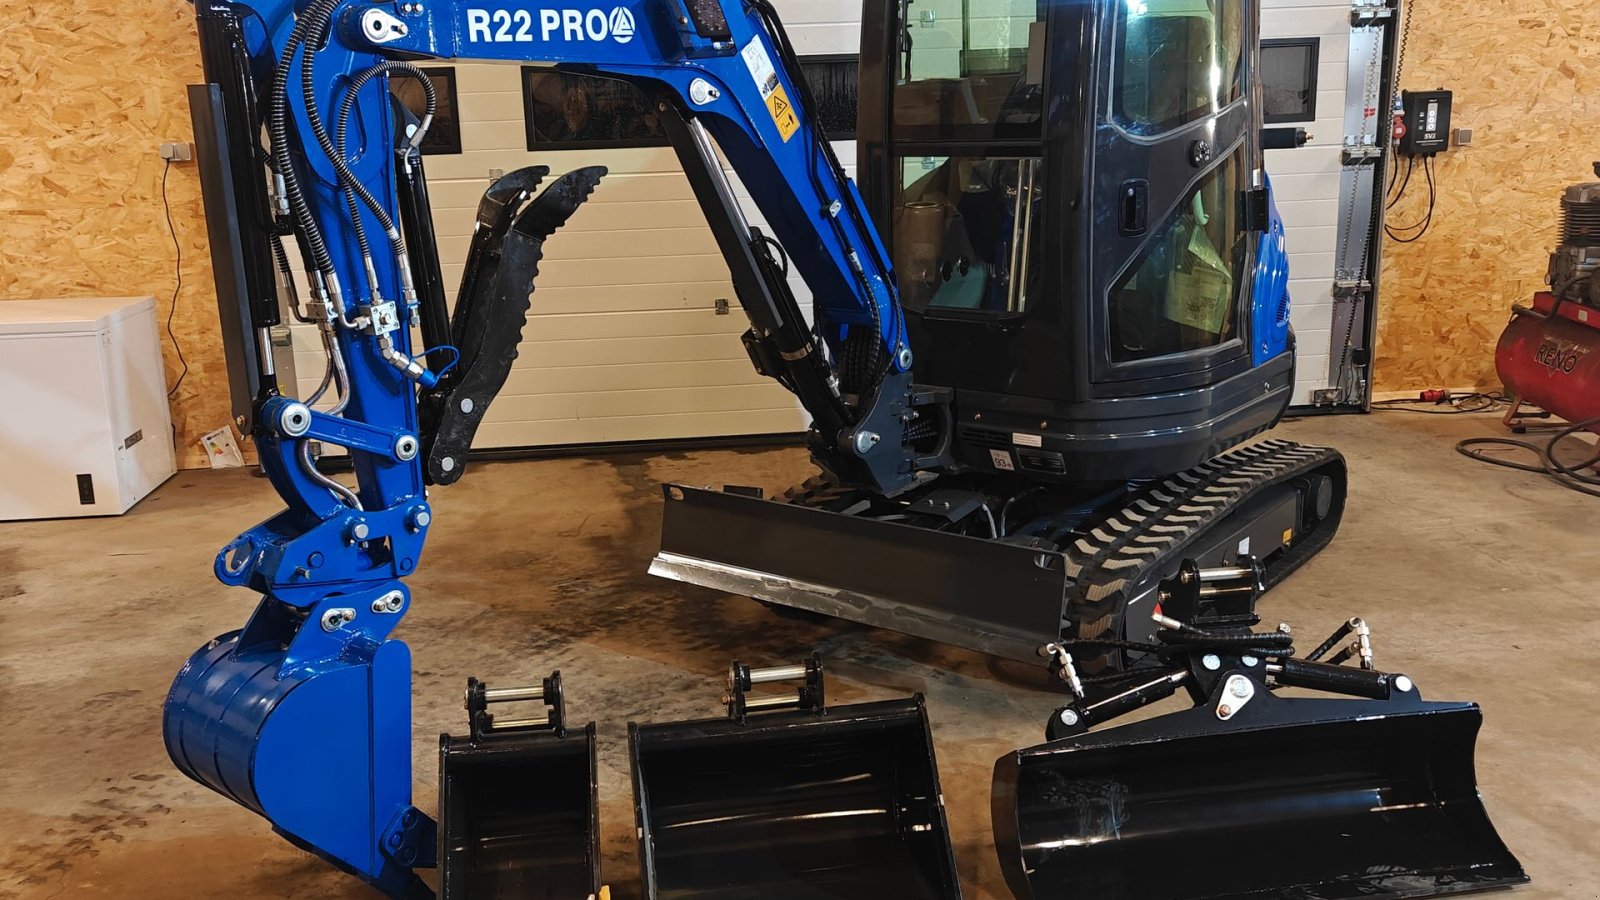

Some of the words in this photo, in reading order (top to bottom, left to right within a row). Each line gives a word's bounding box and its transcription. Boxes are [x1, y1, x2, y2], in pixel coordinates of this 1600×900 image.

[467, 9, 533, 43] R22
[540, 9, 608, 42] PRO
[1534, 344, 1577, 373] RENO
[994, 458, 1007, 467] 93
